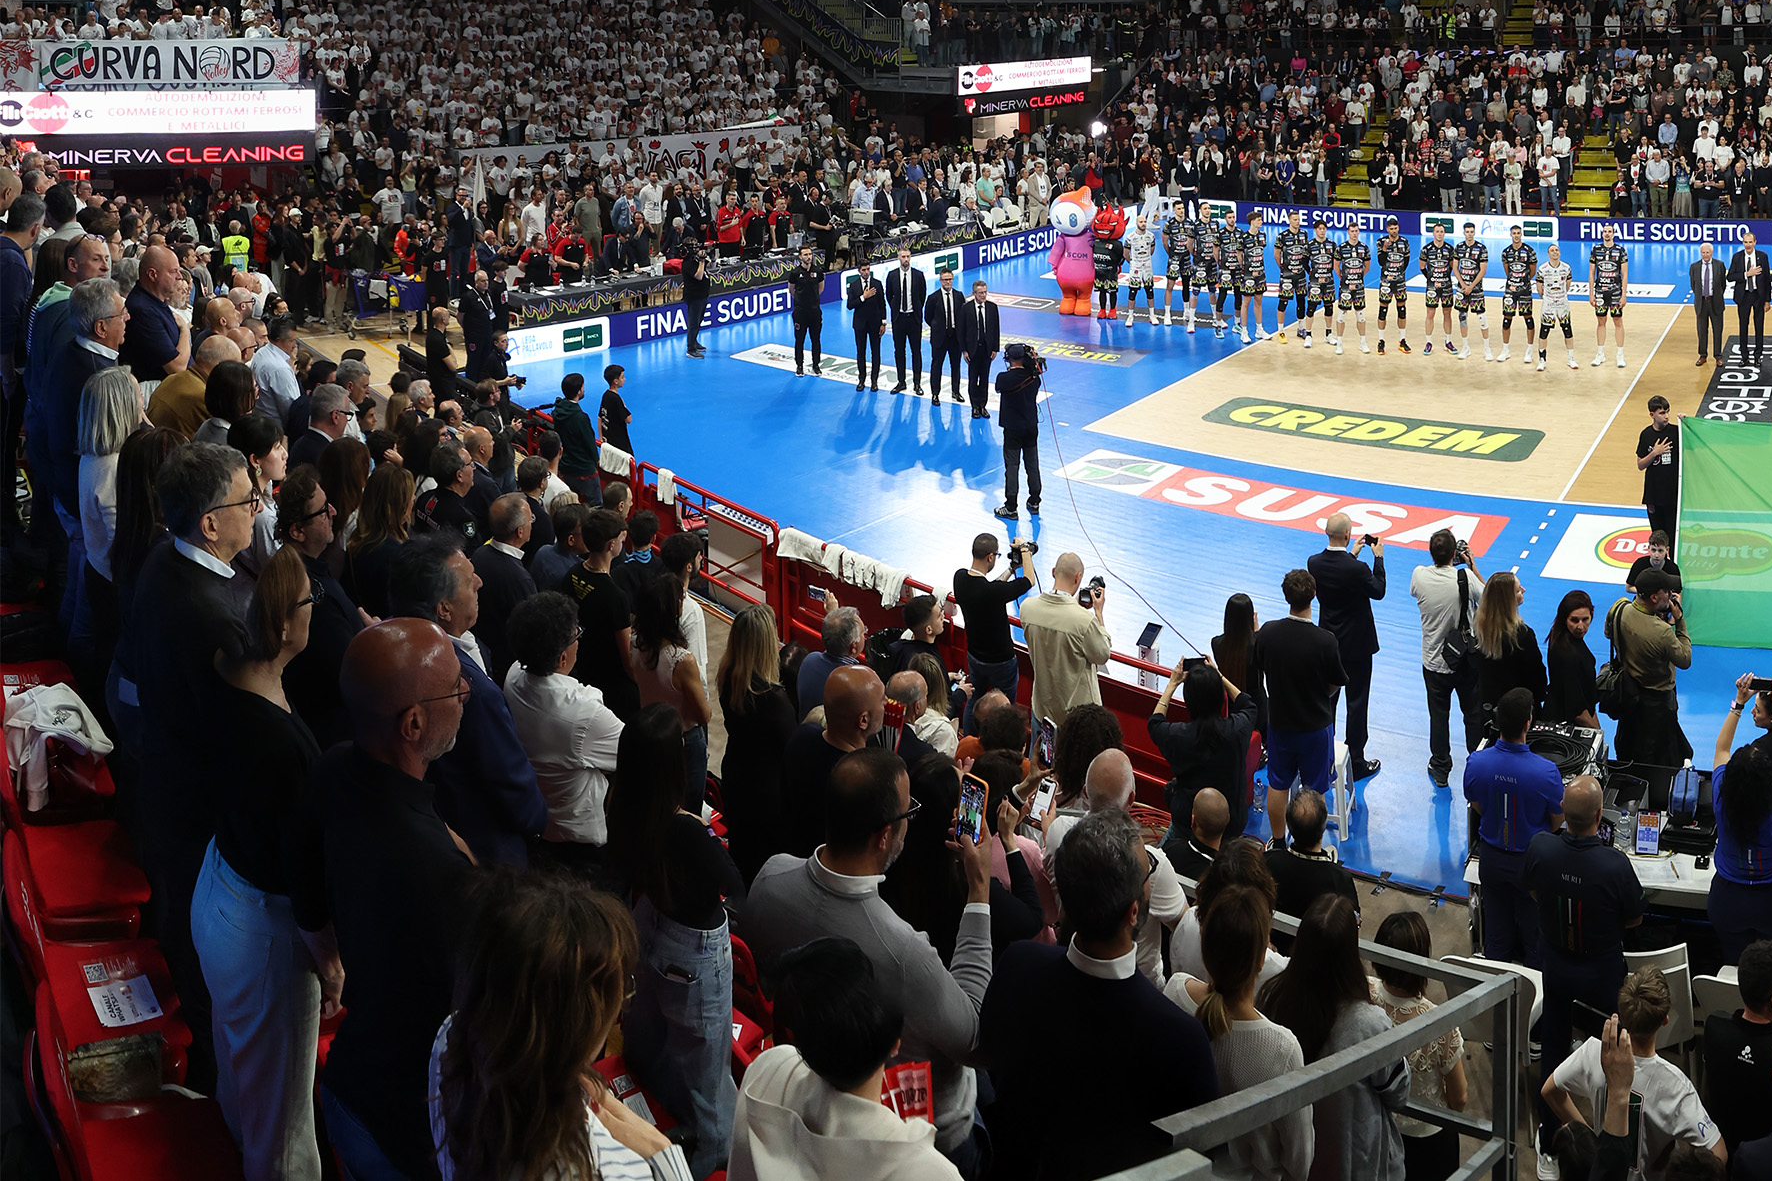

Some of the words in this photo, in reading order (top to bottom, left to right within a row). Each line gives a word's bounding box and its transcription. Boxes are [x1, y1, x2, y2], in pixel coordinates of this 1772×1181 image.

[50, 45, 161, 80] CURVA
[145, 92, 267, 102] AUTODEMOLIZIONE
[980, 98, 1029, 114] MINERVA
[1029, 91, 1085, 108] CLEANING
[108, 107, 189, 117] COMMERCIO
[191, 106, 249, 116] ROTTAMI
[252, 105, 303, 115] FERROSI
[181, 121, 246, 131] METALLICI
[50, 149, 162, 165] MINERVA
[166, 145, 304, 164] CLEANING
[979, 236, 1025, 265] FINALE
[636, 303, 712, 339] FINAE
[717, 287, 793, 323] SCUDET
[1047, 341, 1085, 351] Auto
[1228, 404, 1522, 455] CREDEM
[1162, 476, 1481, 550] SUSA
[1613, 537, 1649, 555] De
